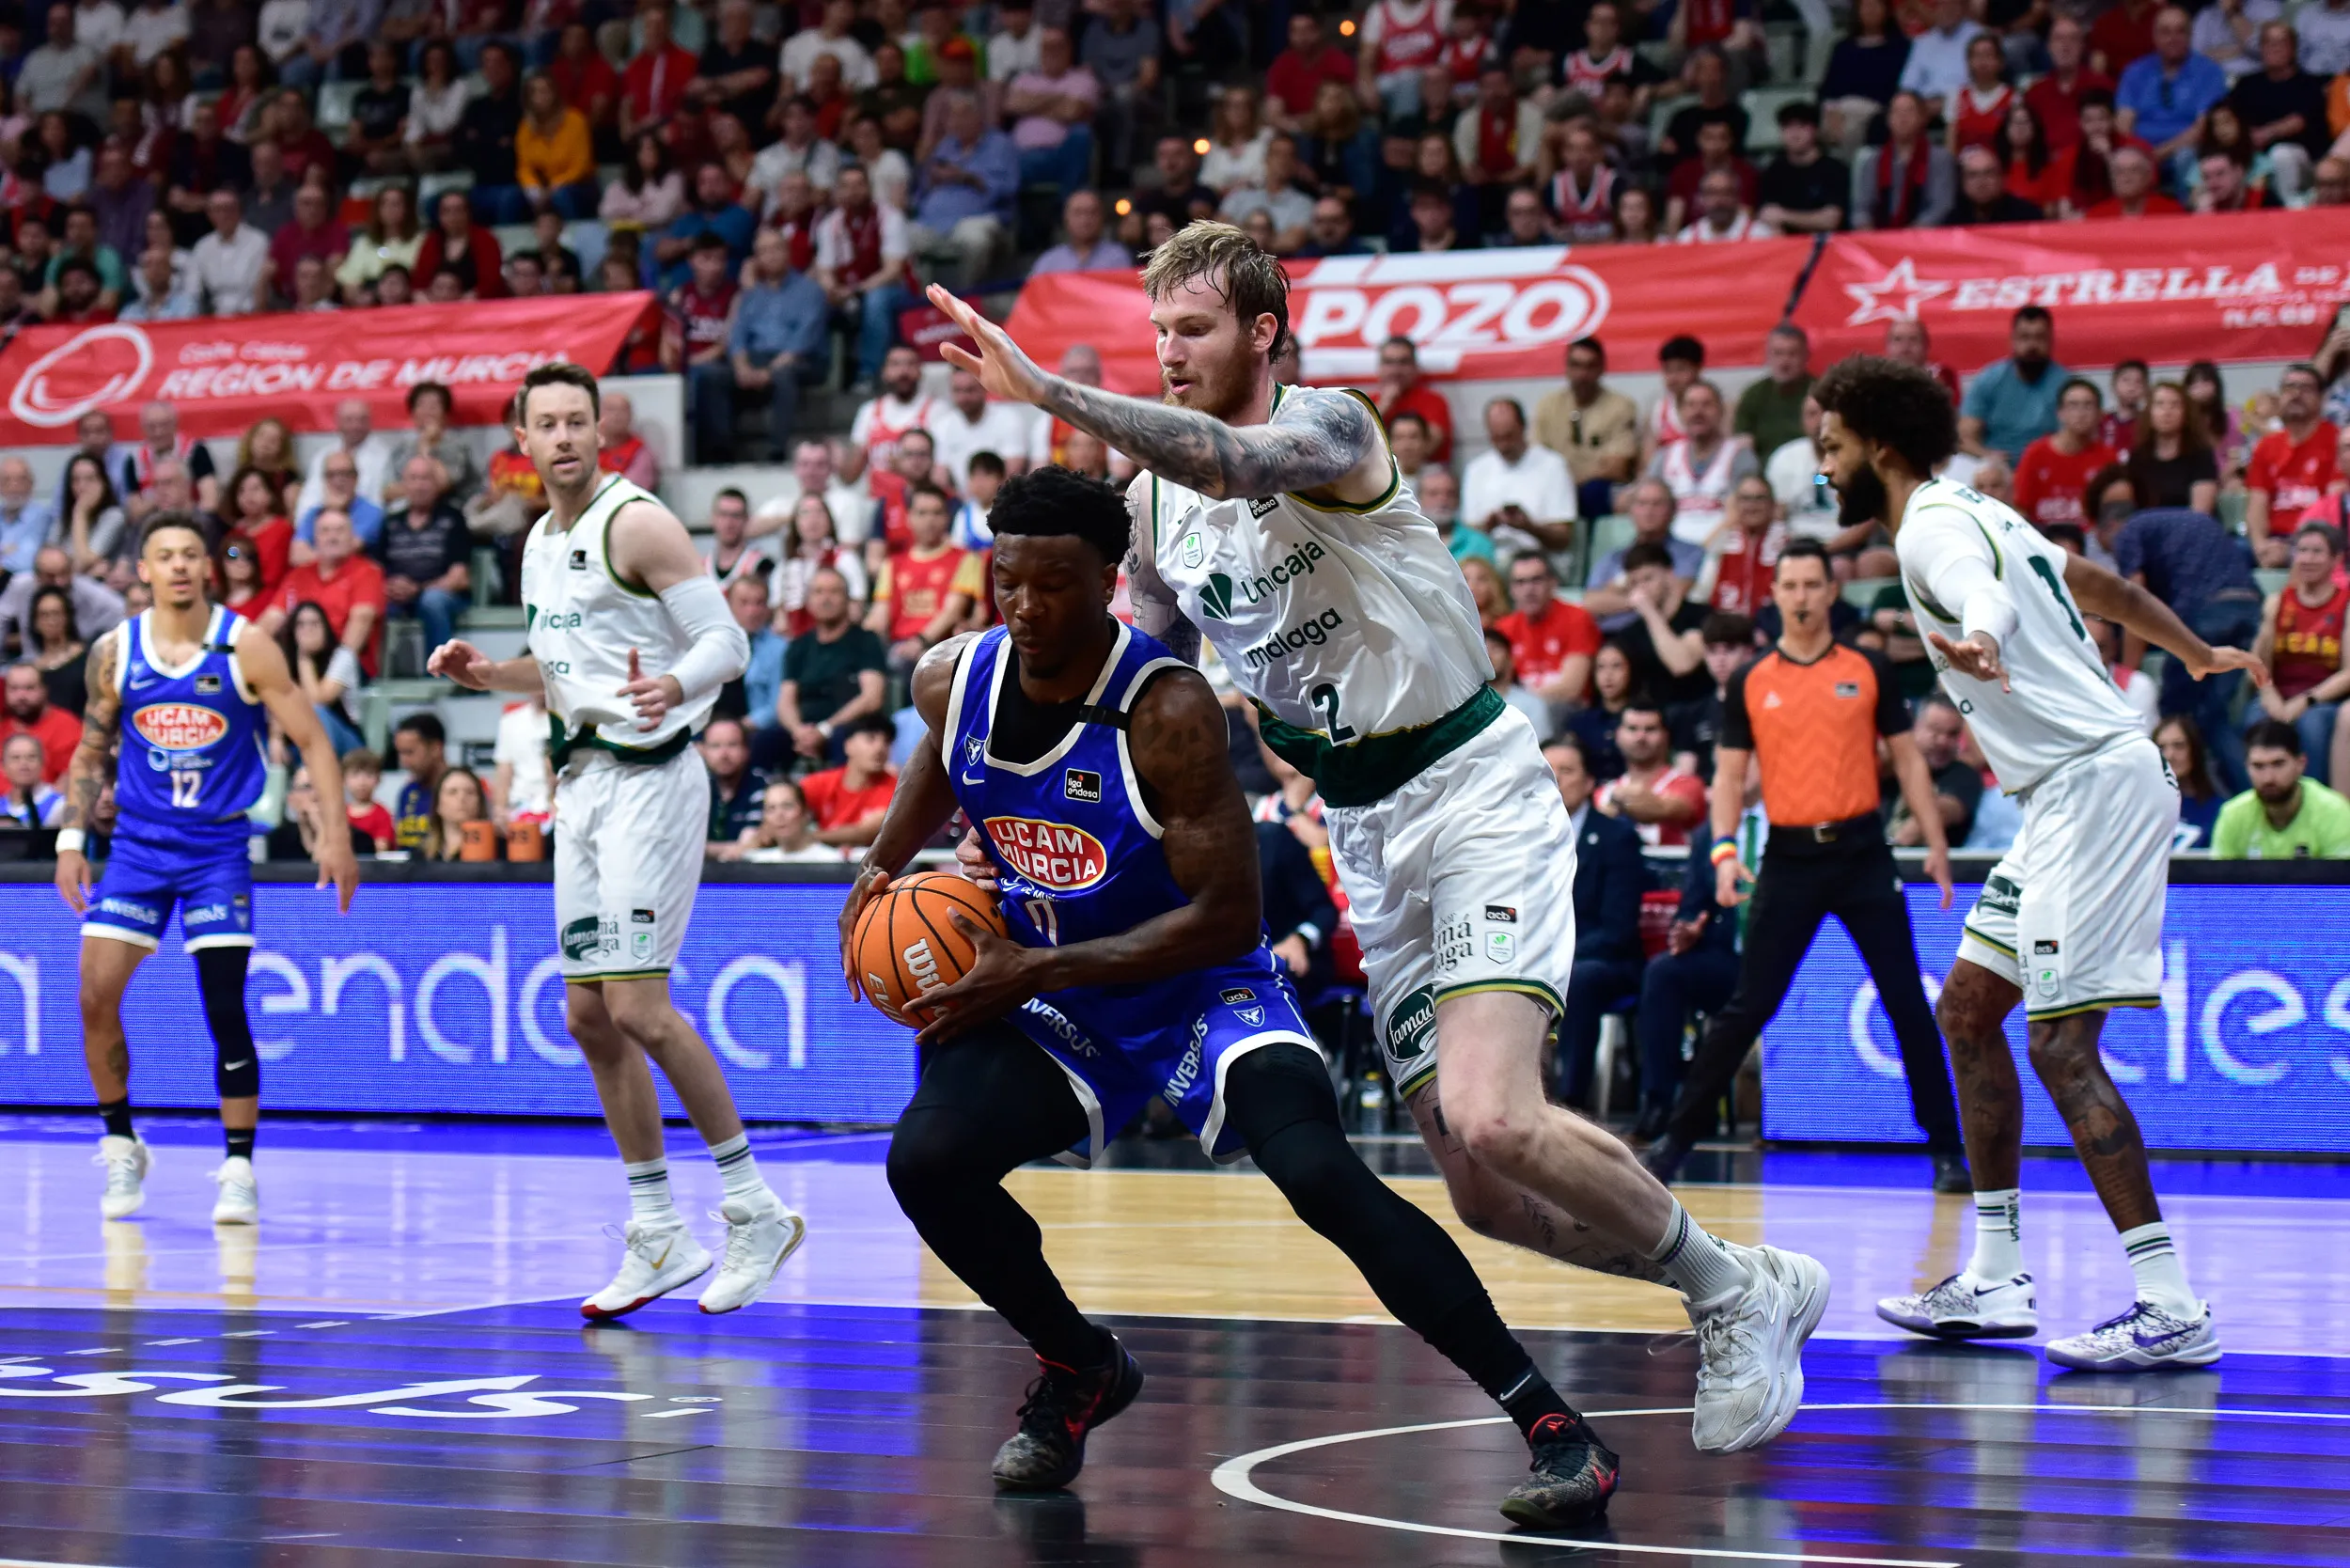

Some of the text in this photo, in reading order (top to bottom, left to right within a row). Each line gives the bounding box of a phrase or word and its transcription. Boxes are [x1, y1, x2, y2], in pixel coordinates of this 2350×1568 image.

[1950, 262, 2281, 311] ESTRELLA
[1297, 280, 1590, 345] POZO
[325, 359, 391, 390] DE
[1240, 540, 1326, 604] Unicaja
[1246, 607, 1343, 668] málaga
[145, 708, 210, 727] UCAM
[1310, 682, 1357, 745] 2
[170, 770, 201, 808] 12
[1067, 787, 1098, 799] endesa
[1068, 776, 1082, 789] liga
[995, 821, 1084, 855] UCAM
[995, 839, 1098, 884] MURCIA
[1486, 910, 1512, 921] acb
[1226, 992, 1248, 1003] acb
